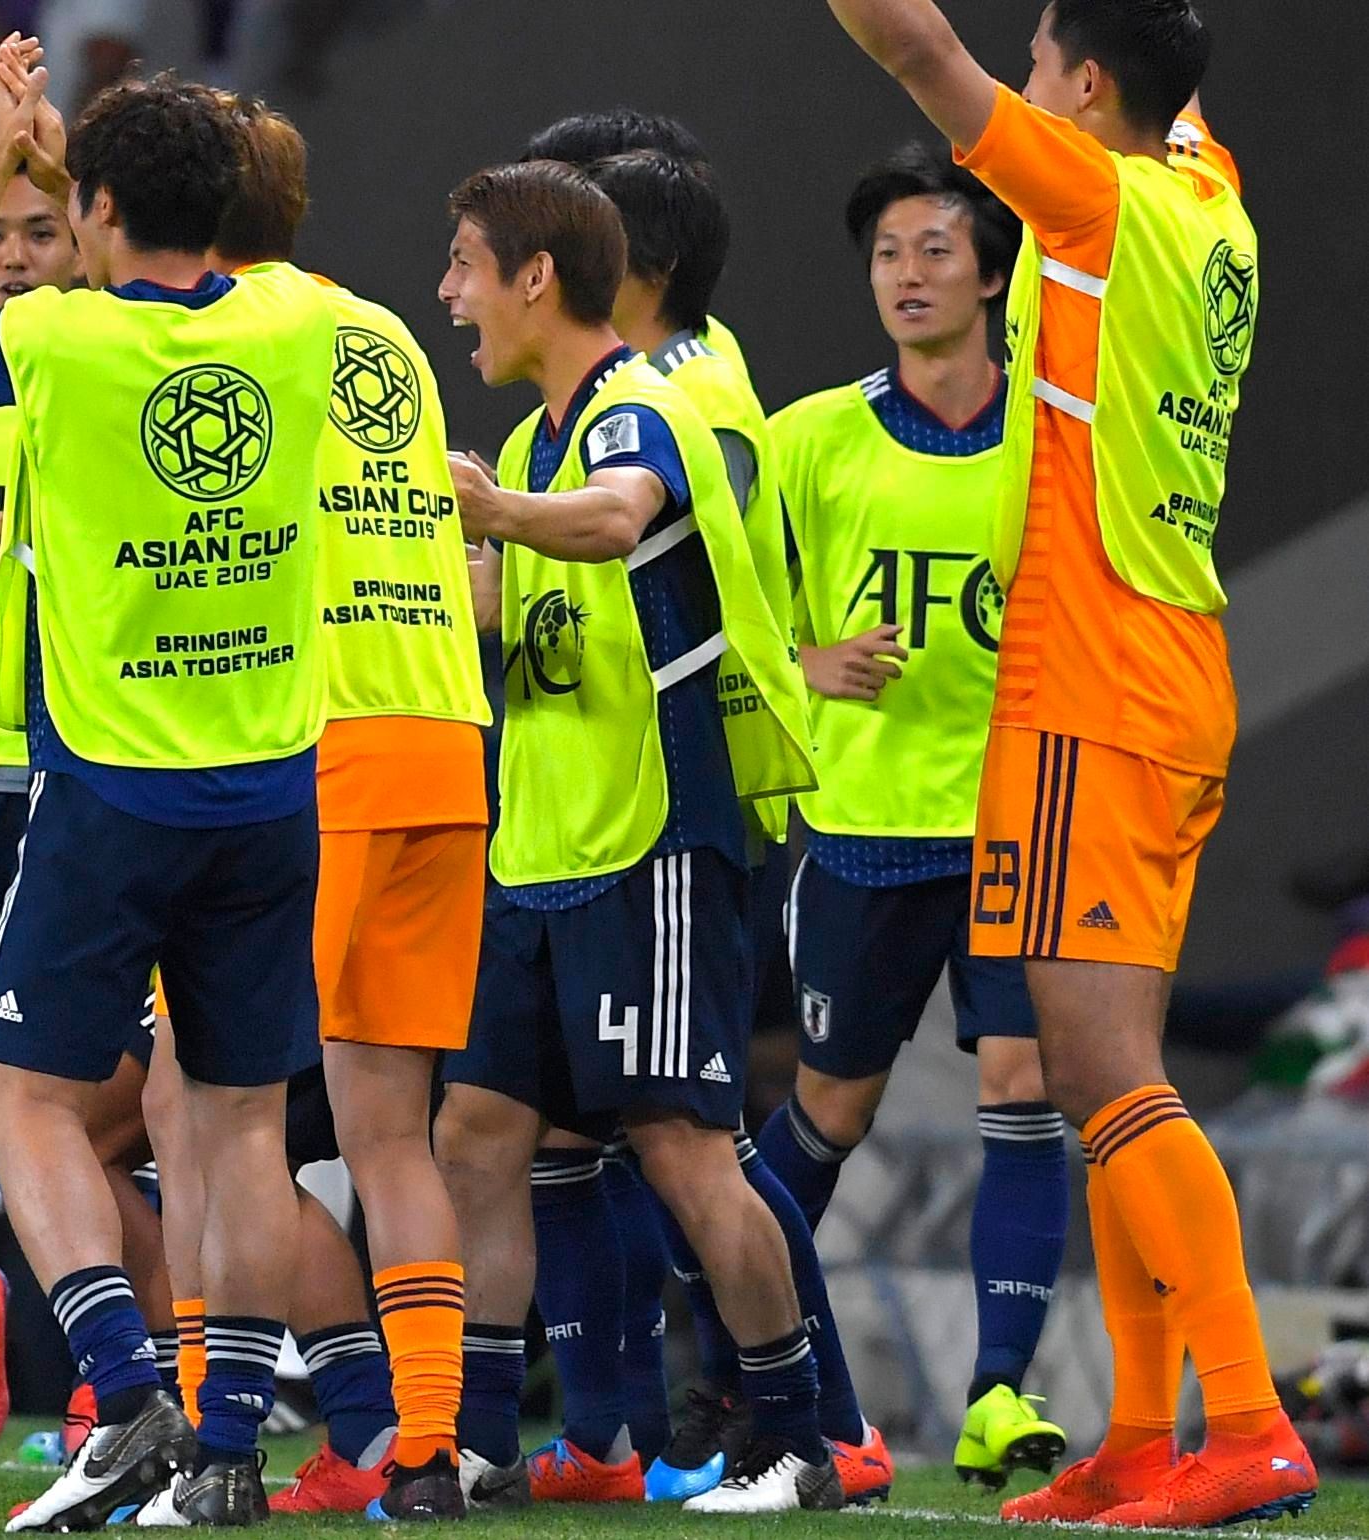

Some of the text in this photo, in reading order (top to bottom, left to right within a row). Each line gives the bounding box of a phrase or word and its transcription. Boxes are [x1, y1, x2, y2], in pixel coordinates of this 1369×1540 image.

[1158, 391, 1224, 435] ASIAN
[362, 461, 409, 483] AFC
[319, 485, 454, 521] ASIAN CUP
[184, 507, 243, 534] AFC
[345, 517, 435, 540] UAE 2019
[115, 523, 298, 568] ASIAN CUP
[156, 570, 208, 589] UAE
[353, 580, 442, 602] BRINGING
[838, 548, 999, 653] AFC
[323, 604, 375, 624] ASIA
[156, 626, 268, 652] BRINGING
[120, 644, 294, 679] ASIA TOGETHER
[975, 839, 1020, 924] 23
[1078, 918, 1119, 930] adidas
[599, 993, 639, 1076] 4
[699, 1069, 731, 1083] adidas
